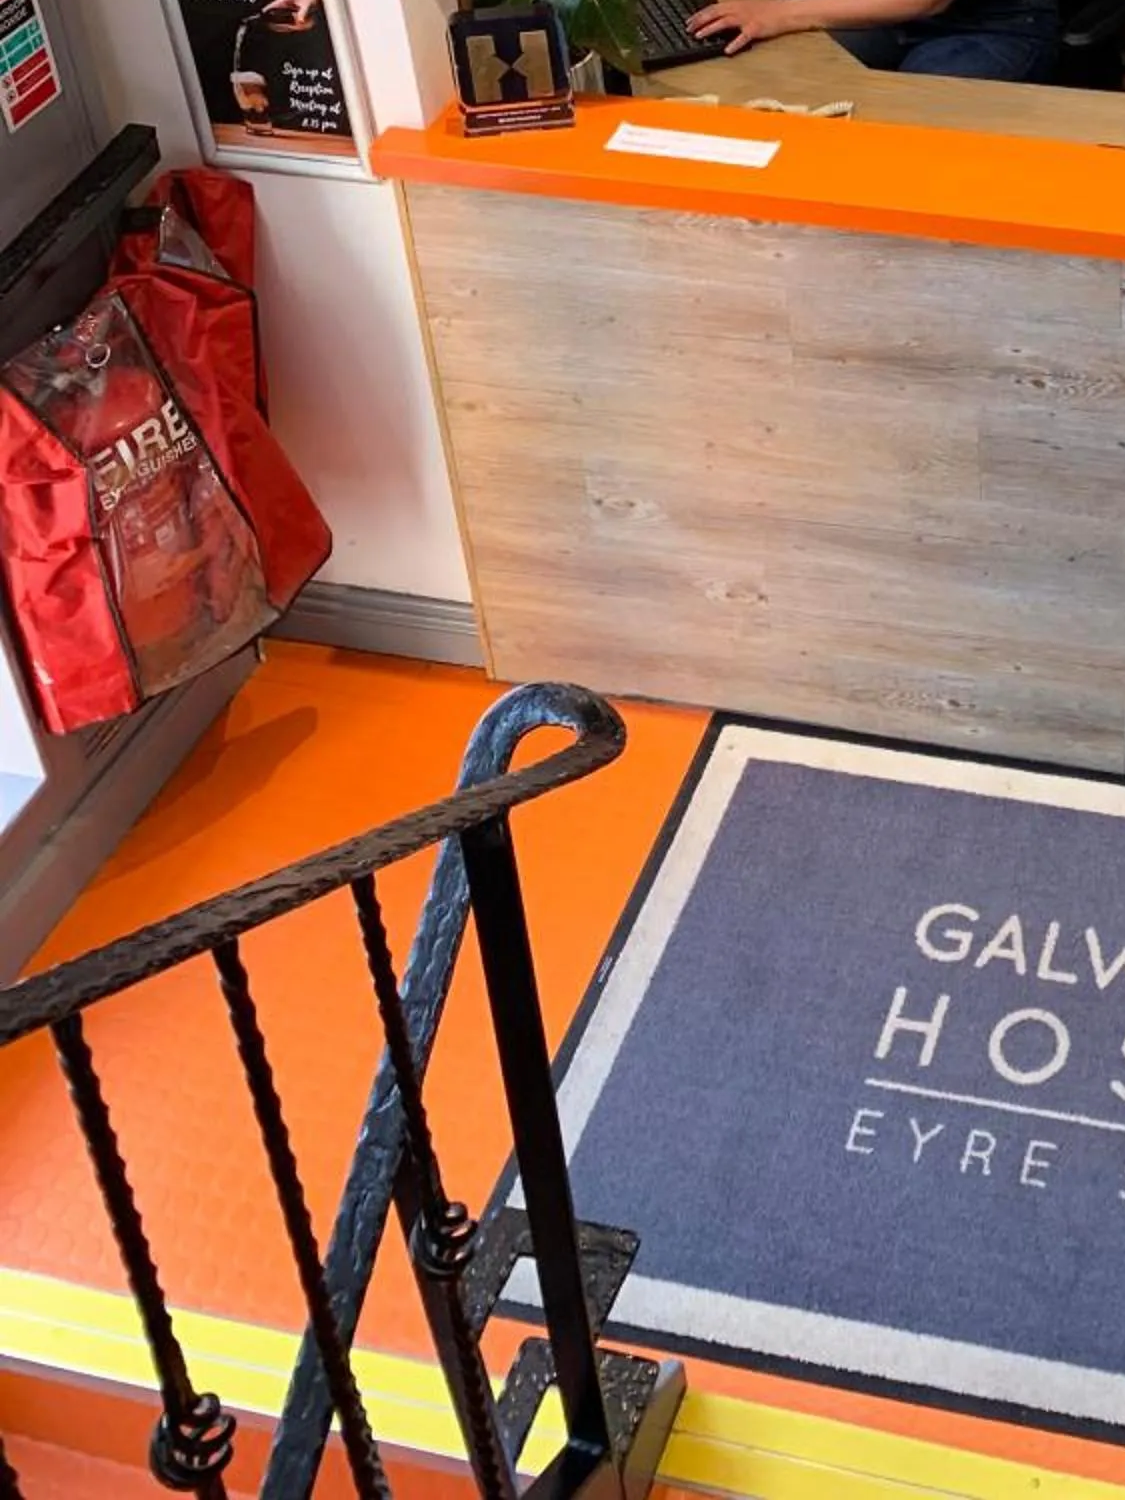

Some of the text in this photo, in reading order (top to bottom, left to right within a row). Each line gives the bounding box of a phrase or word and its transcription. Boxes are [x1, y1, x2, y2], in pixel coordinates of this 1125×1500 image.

[281, 61, 304, 79] Sign
[289, 80, 334, 97] Reception
[289, 97, 328, 117] Meeting
[87, 399, 189, 493] FIRE
[845, 1107, 1058, 1189] EYRE
